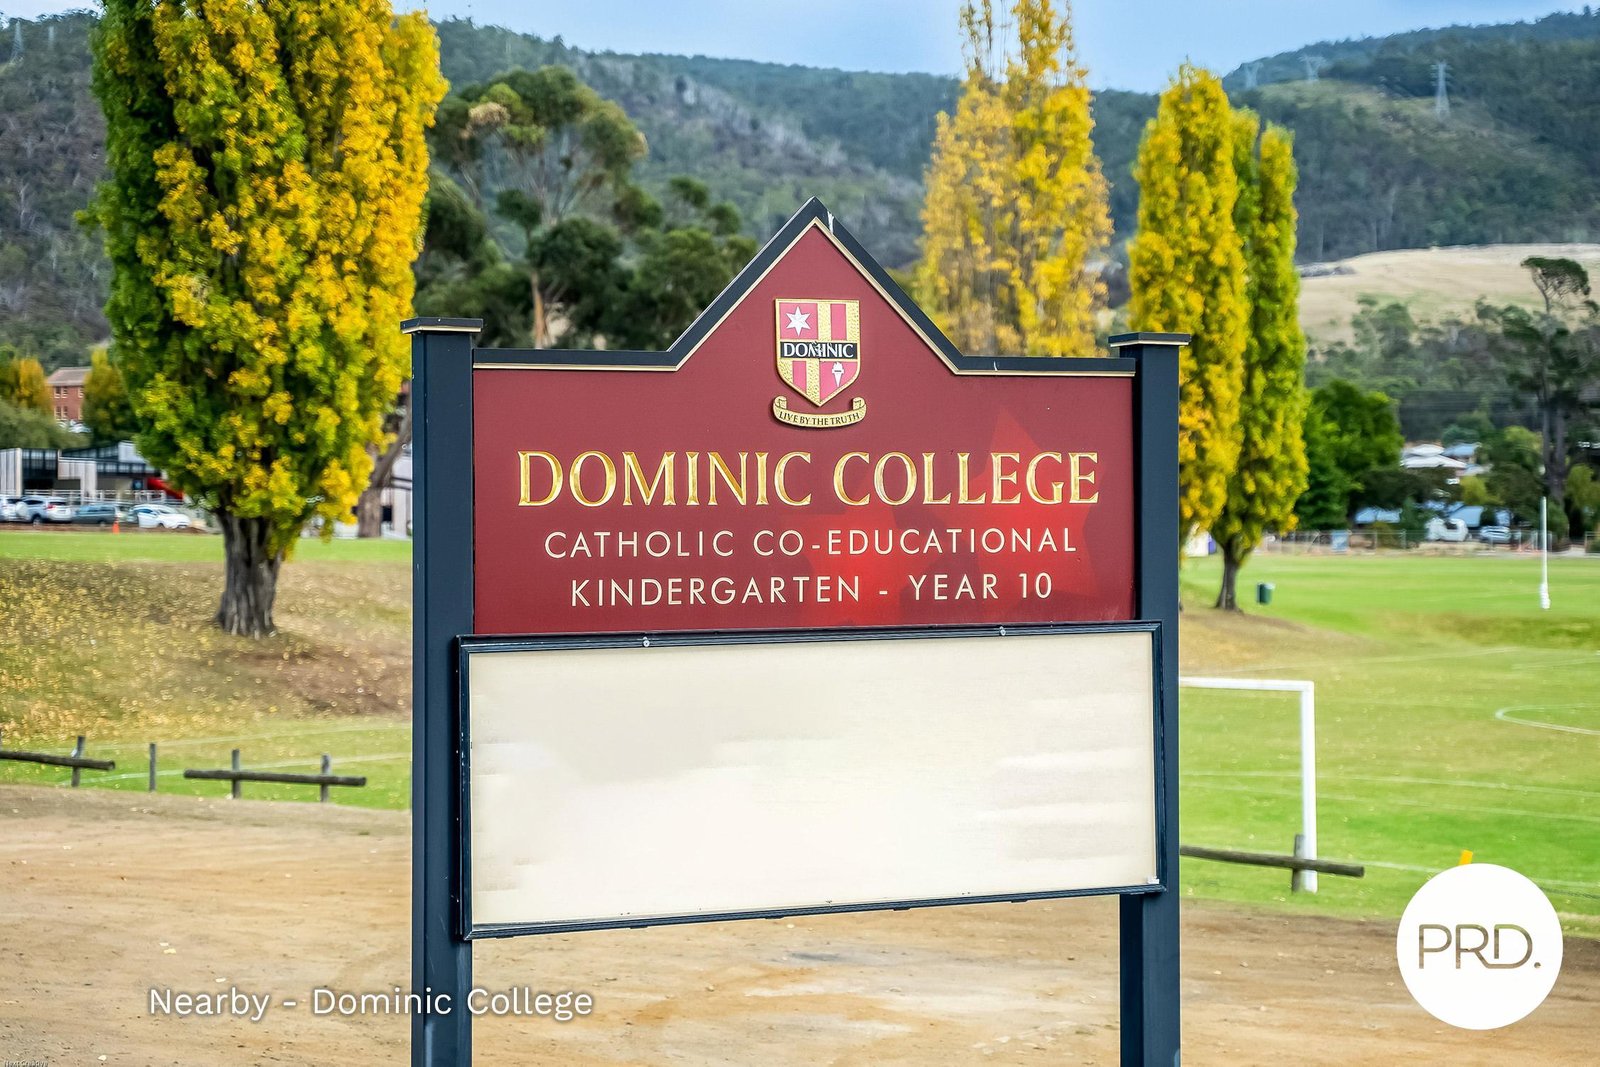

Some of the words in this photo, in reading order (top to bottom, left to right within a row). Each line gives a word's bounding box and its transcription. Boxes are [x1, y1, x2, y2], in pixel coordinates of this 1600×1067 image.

[783, 343, 853, 358] DOMINIC
[779, 411, 798, 422] LIVE
[799, 415, 810, 424] BY
[812, 417, 829, 426] THE
[830, 412, 860, 424] TRUTH
[517, 450, 812, 507] DOMINIC
[833, 450, 1100, 506] COLLEGE
[544, 529, 737, 559] CATHOLIC
[753, 527, 1077, 558] CO-EDUCATIONAL
[571, 576, 860, 607] KINDERGARTEN
[909, 573, 998, 601] YEAR
[1019, 571, 1053, 600] 10
